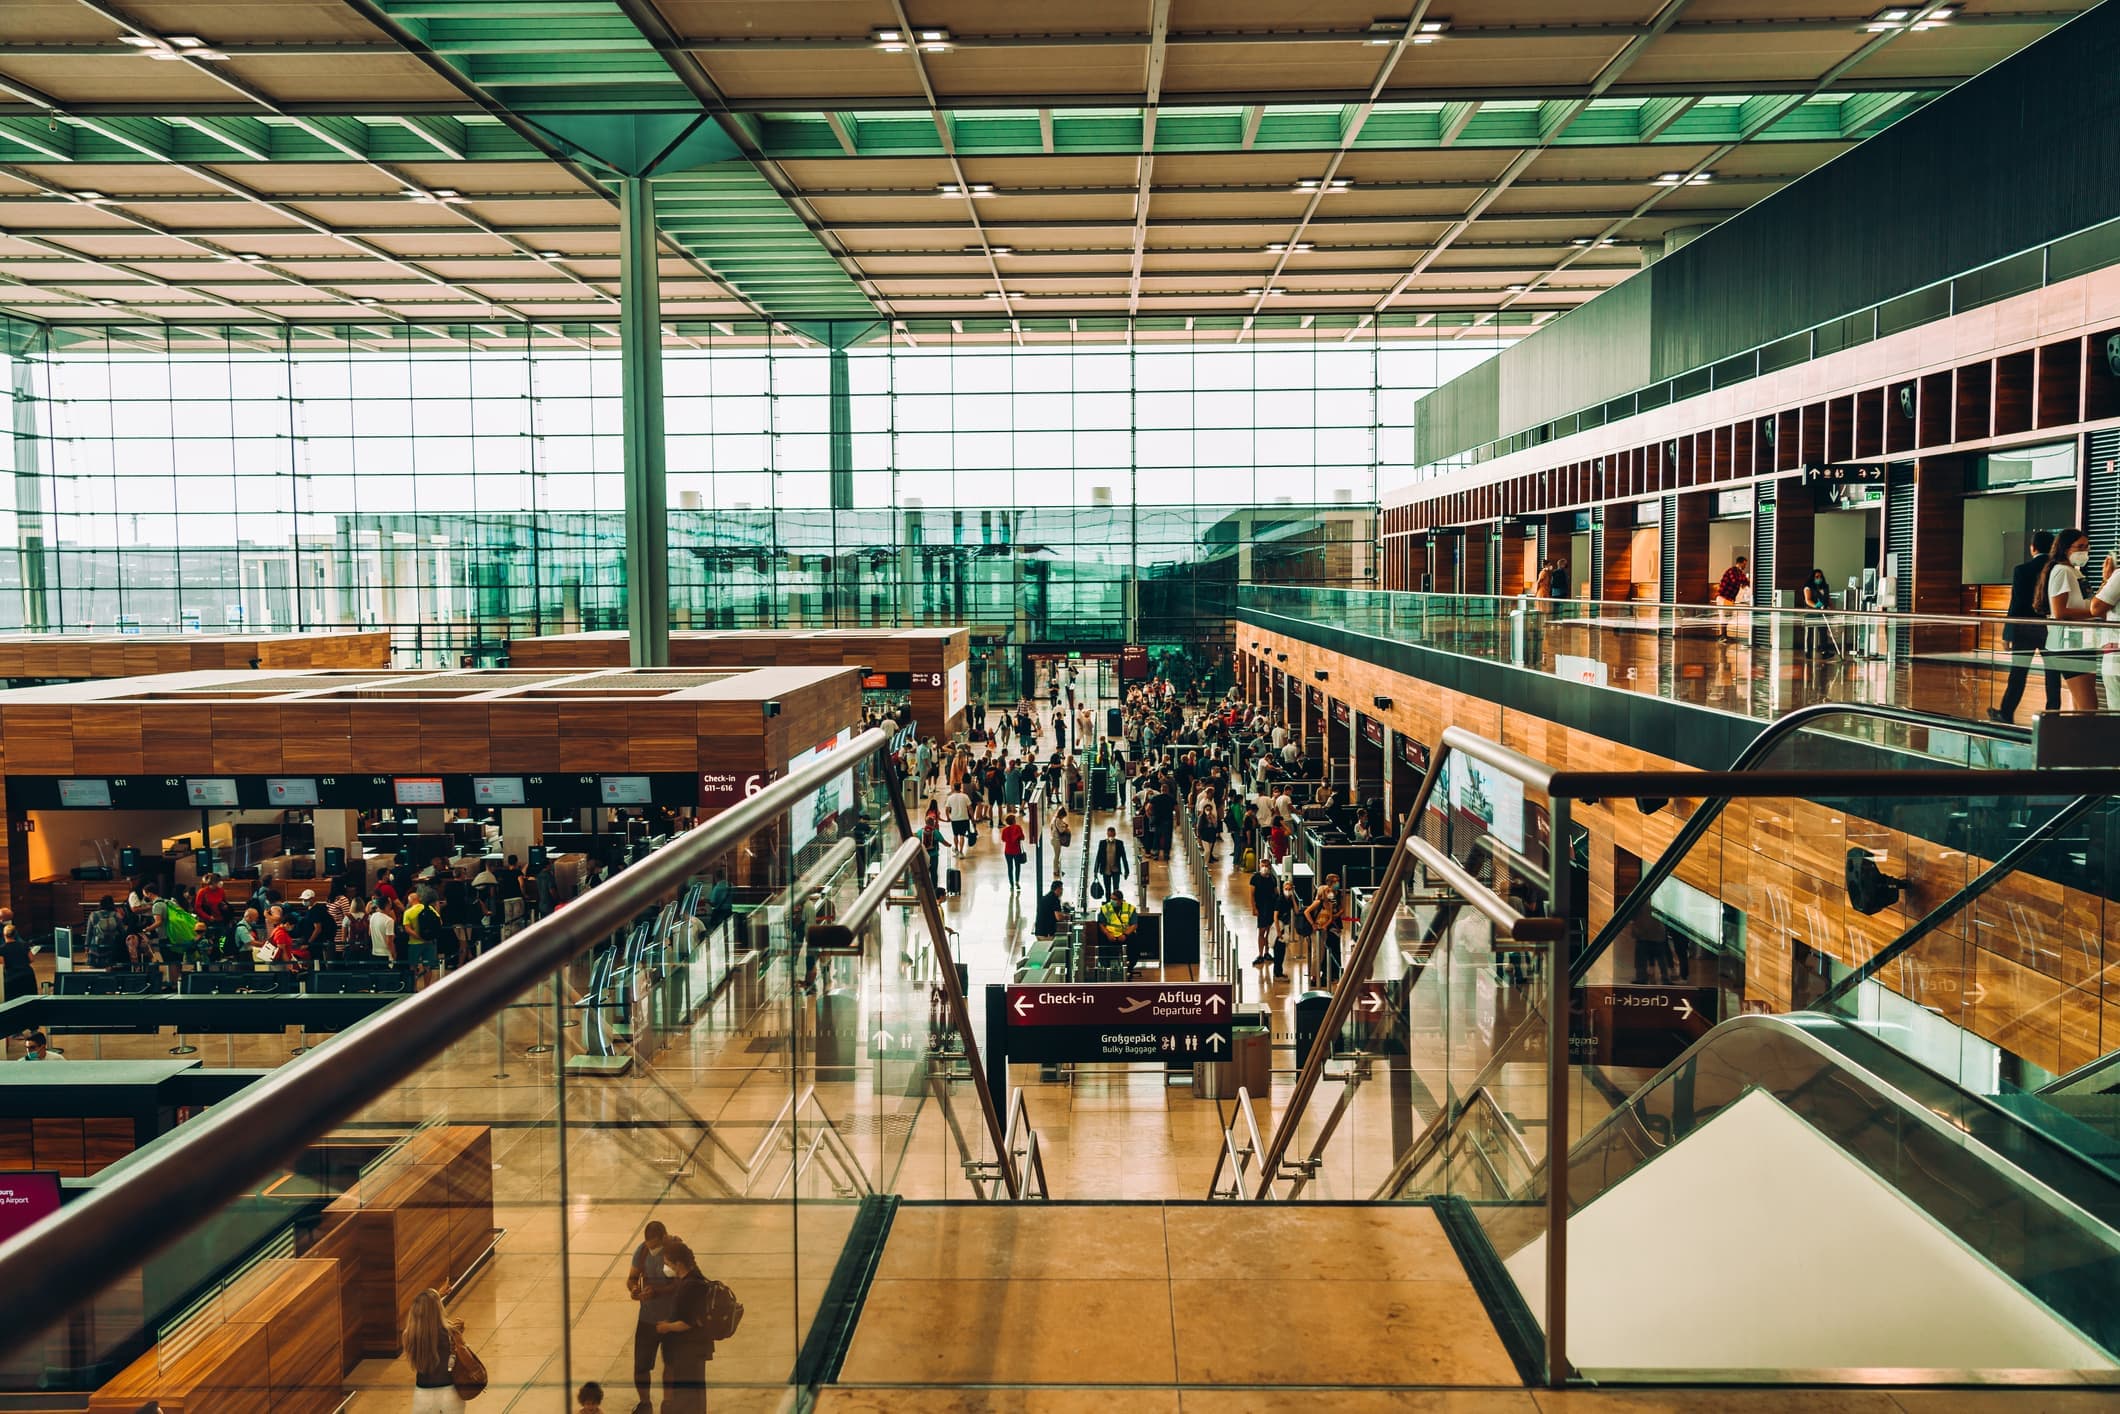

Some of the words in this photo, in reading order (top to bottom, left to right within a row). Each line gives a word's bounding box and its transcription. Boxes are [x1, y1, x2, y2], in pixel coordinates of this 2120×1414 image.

[932, 673, 941, 686] 8
[114, 779, 127, 787] 611
[373, 777, 386, 785] 614
[704, 774, 736, 782] Check-in
[745, 774, 762, 798] 6
[1039, 992, 1095, 1004] Check-in
[1158, 991, 1201, 1004] Abflug
[1153, 1006, 1202, 1016] Departure
[1101, 1033, 1157, 1044] Großgepäck
[1102, 1046, 1123, 1054] Bulky
[1125, 1046, 1157, 1054] Baggage
[6, 1197, 29, 1205] Airport
